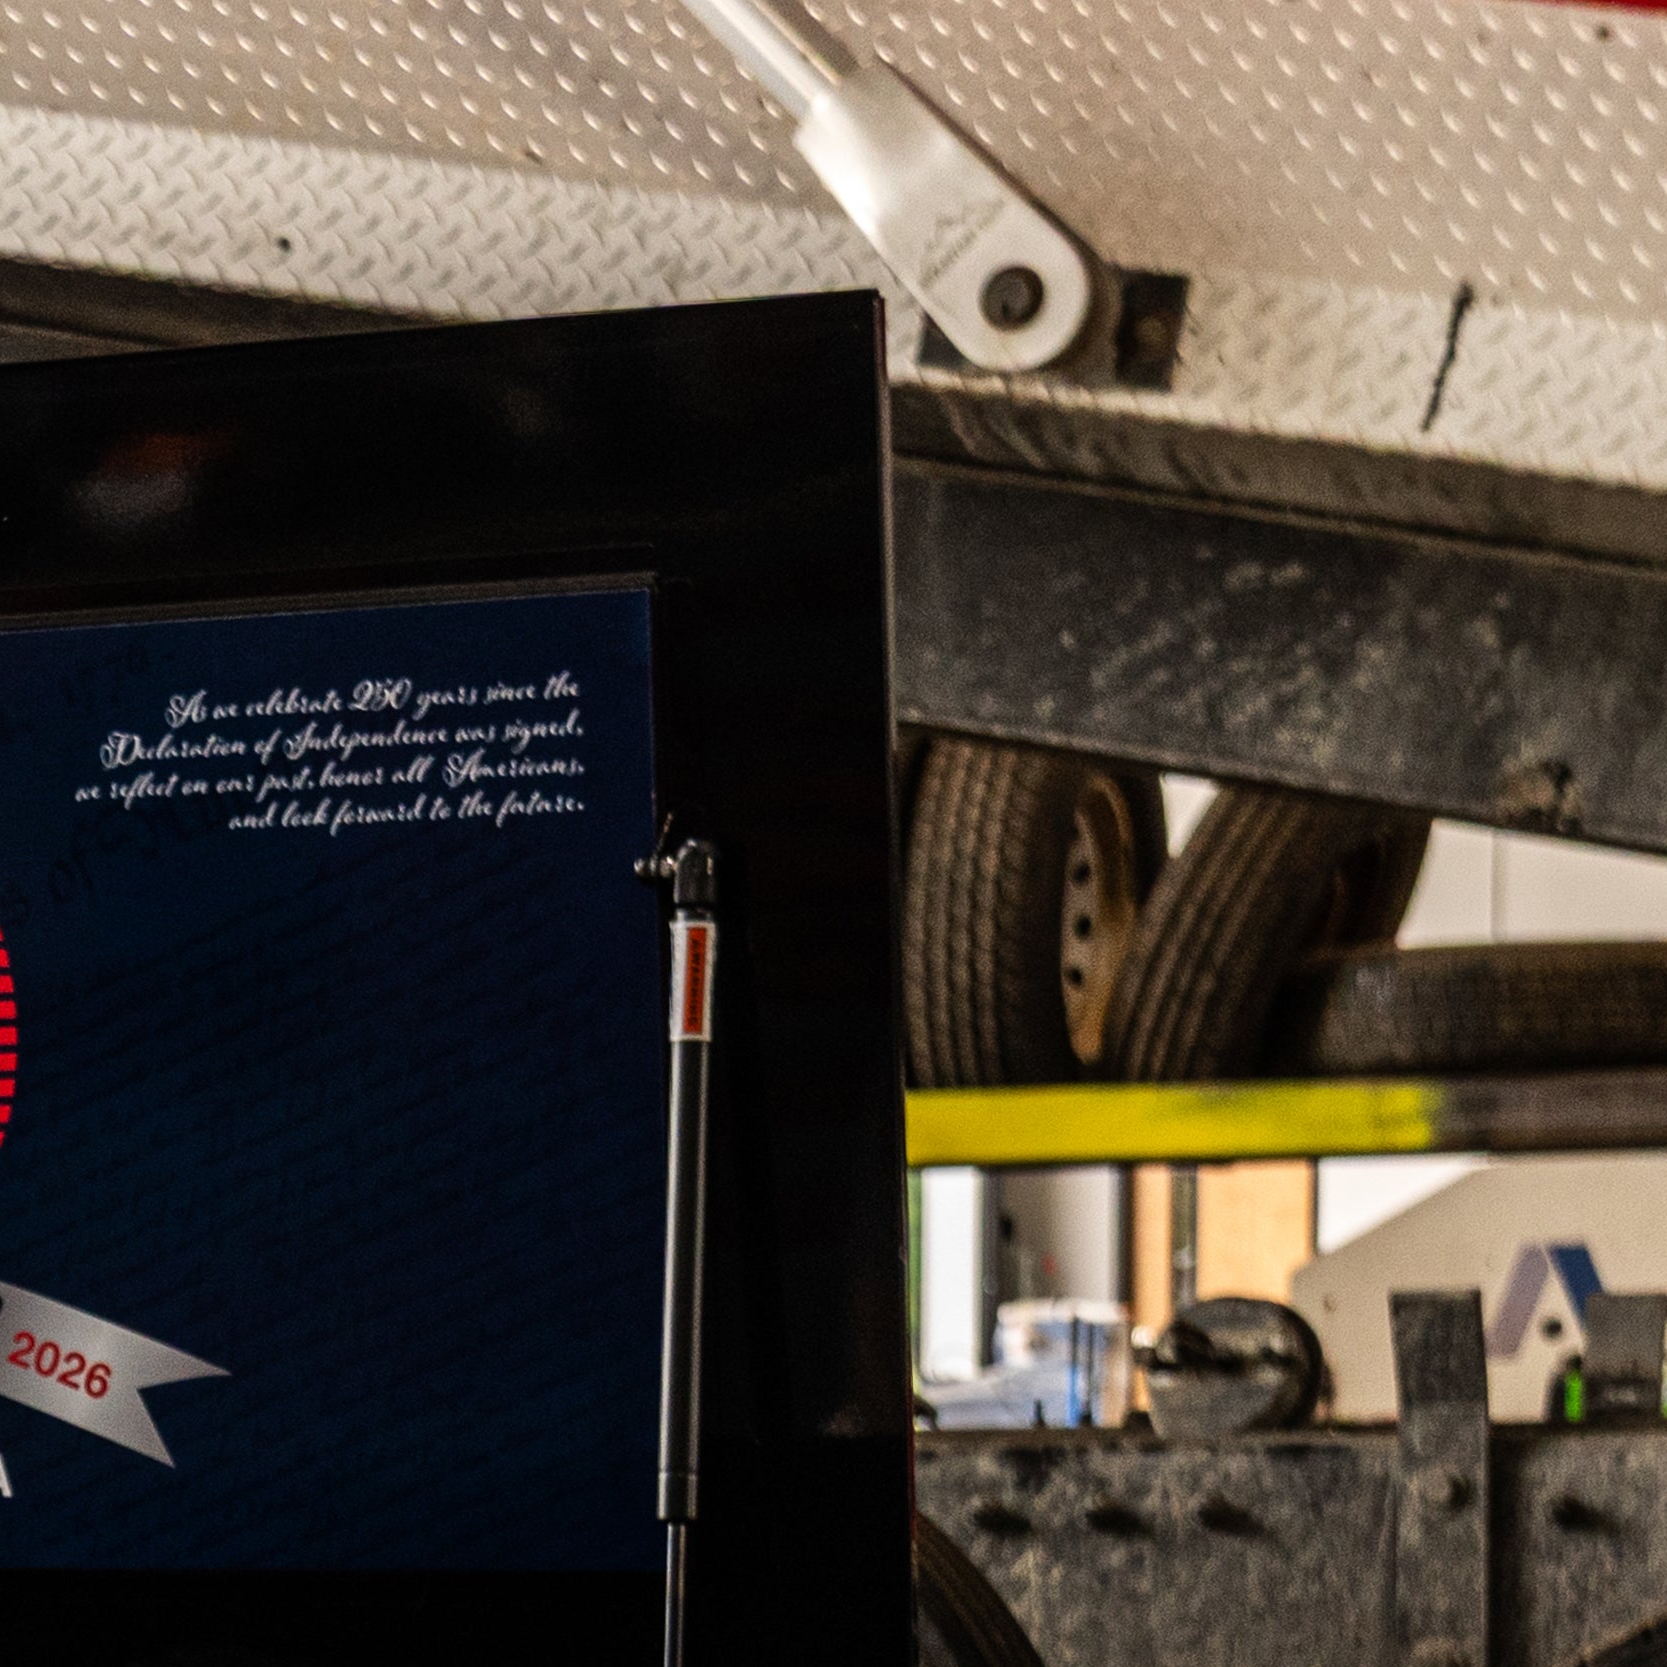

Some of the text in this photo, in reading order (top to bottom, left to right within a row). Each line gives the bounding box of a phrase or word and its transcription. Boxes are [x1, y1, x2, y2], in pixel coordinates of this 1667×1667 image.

[165, 669, 579, 728] As we celebrate 250 years since the
[100, 731, 247, 770] Declaration
[254, 728, 282, 765] of
[283, 717, 448, 762] Independence
[455, 724, 495, 743] was
[74, 785, 100, 802] we
[109, 770, 179, 811] reflect
[181, 781, 208, 796] on
[216, 774, 254, 794] our
[391, 755, 436, 784] all
[228, 800, 279, 830] and
[280, 797, 331, 828] look
[328, 792, 427, 837] forward
[429, 796, 452, 821] to
[457, 790, 492, 820] the
[6, 1330, 114, 1402] 2026
